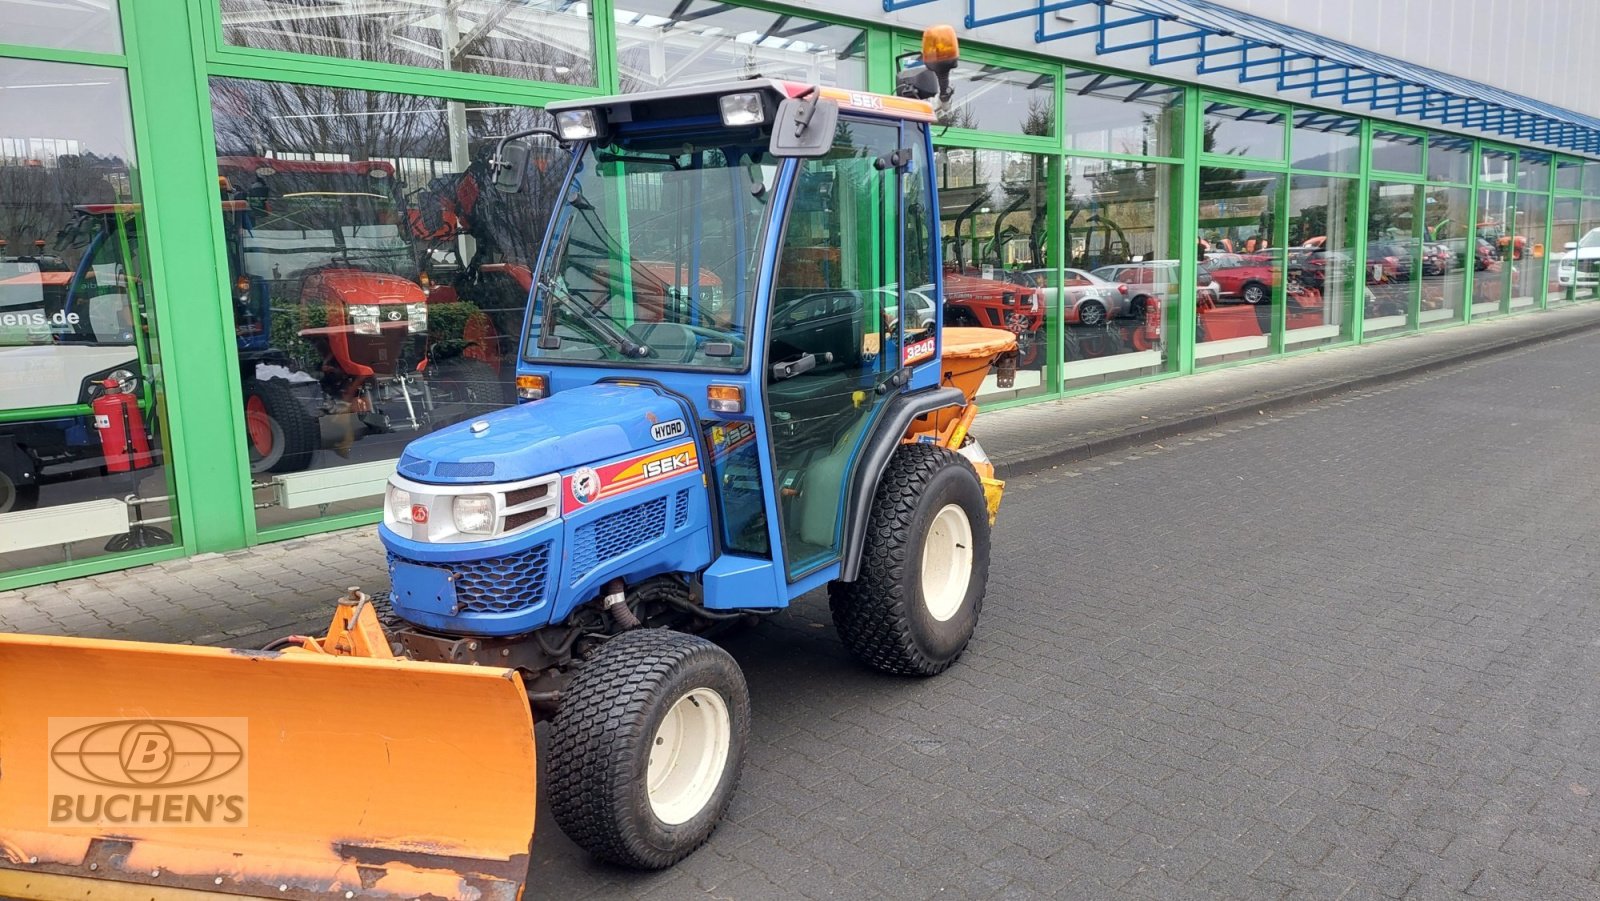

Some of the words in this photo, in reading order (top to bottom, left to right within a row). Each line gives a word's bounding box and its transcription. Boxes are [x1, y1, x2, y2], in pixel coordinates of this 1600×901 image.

[849, 93, 883, 110] ISEKI
[907, 339, 935, 359] 3240
[655, 421, 683, 438] HYDRO
[642, 452, 691, 479] ISEKI
